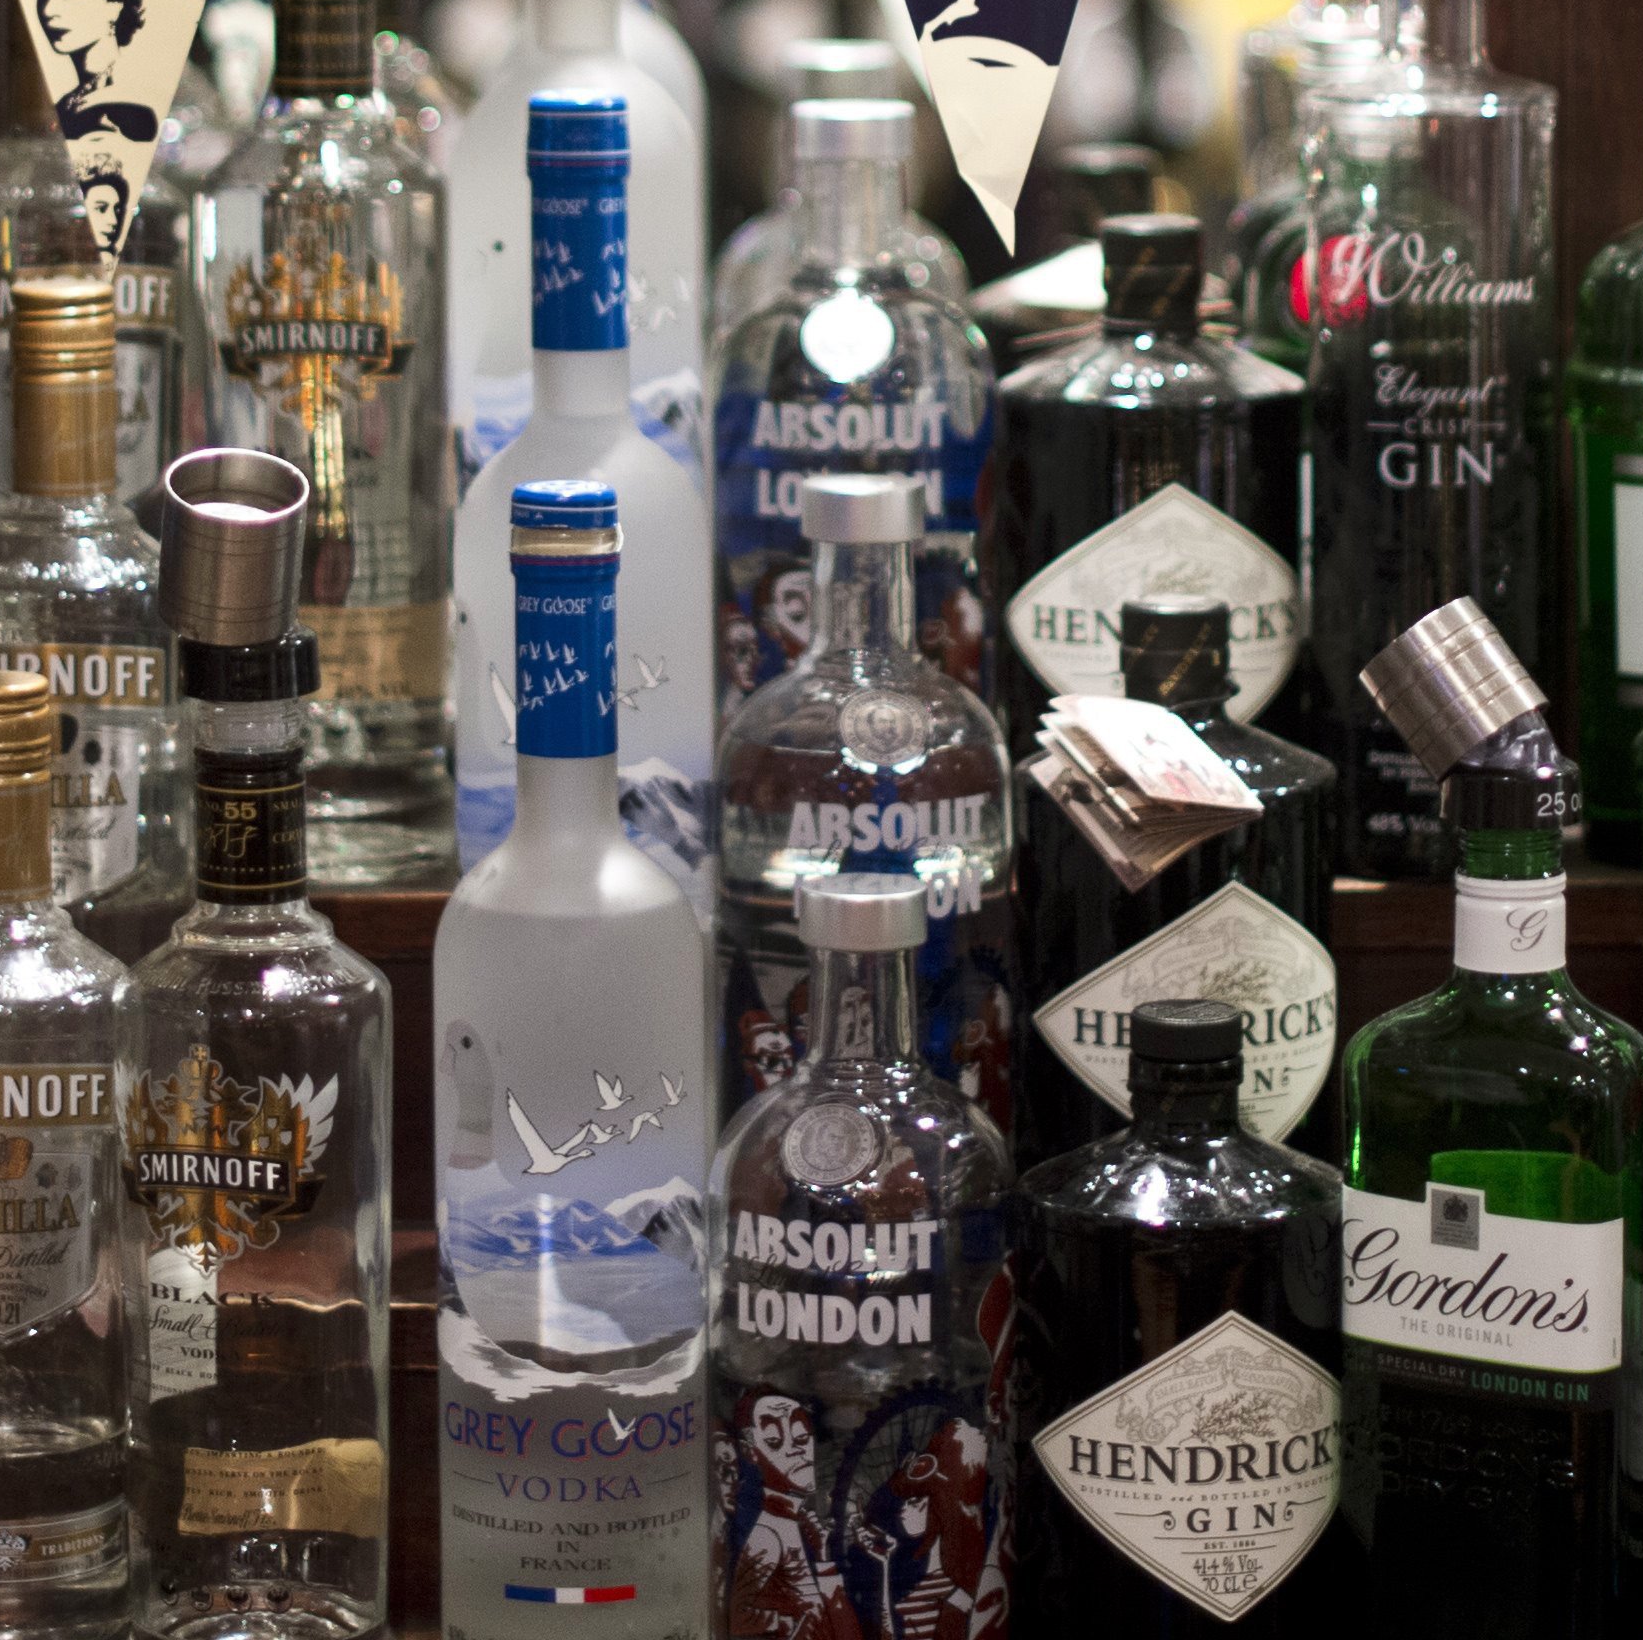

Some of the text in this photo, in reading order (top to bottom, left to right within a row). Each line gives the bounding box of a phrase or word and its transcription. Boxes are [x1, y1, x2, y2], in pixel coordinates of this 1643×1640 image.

[1330, 231, 1534, 306] Williams
[241, 320, 383, 356] SMIRNOFF
[1374, 363, 1495, 418] Elegant
[753, 401, 946, 451] ABSOLUT
[1378, 443, 1495, 488] GIN
[758, 468, 944, 519] LON
[543, 596, 587, 614] GOOSE
[224, 801, 257, 819] 55
[788, 792, 991, 853] ABSOLUT
[1537, 792, 1565, 817] 25
[139, 1153, 282, 1191] SMIRNOFF
[733, 1210, 938, 1271] ABSOLUT
[151, 1283, 275, 1307] BLACK
[1344, 1219, 1590, 1334] Gordon's
[6, 1303, 21, 1325] 21
[150, 1304, 202, 1341] Small
[737, 1282, 932, 1346] LONDON
[1400, 1317, 1513, 1348] THE ORIGINAL
[1439, 1364, 1466, 1378] DRY
[1470, 1370, 1547, 1398] LONDON
[1553, 1382, 1590, 1402] GIN
[445, 1400, 699, 1461] GREY GOOSE
[1069, 1426, 1342, 1486] HENDRICK'
[497, 1472, 643, 1502] VODKA
[1080, 1485, 1163, 1502] DISTILLED
[1201, 1487, 1270, 1502] BOTTLED
[453, 1503, 692, 1536] DISTILLED AND BOTTLED
[1186, 1501, 1278, 1534] GIN
[520, 1555, 612, 1572] FRANCE
[557, 1540, 580, 1554] IN
